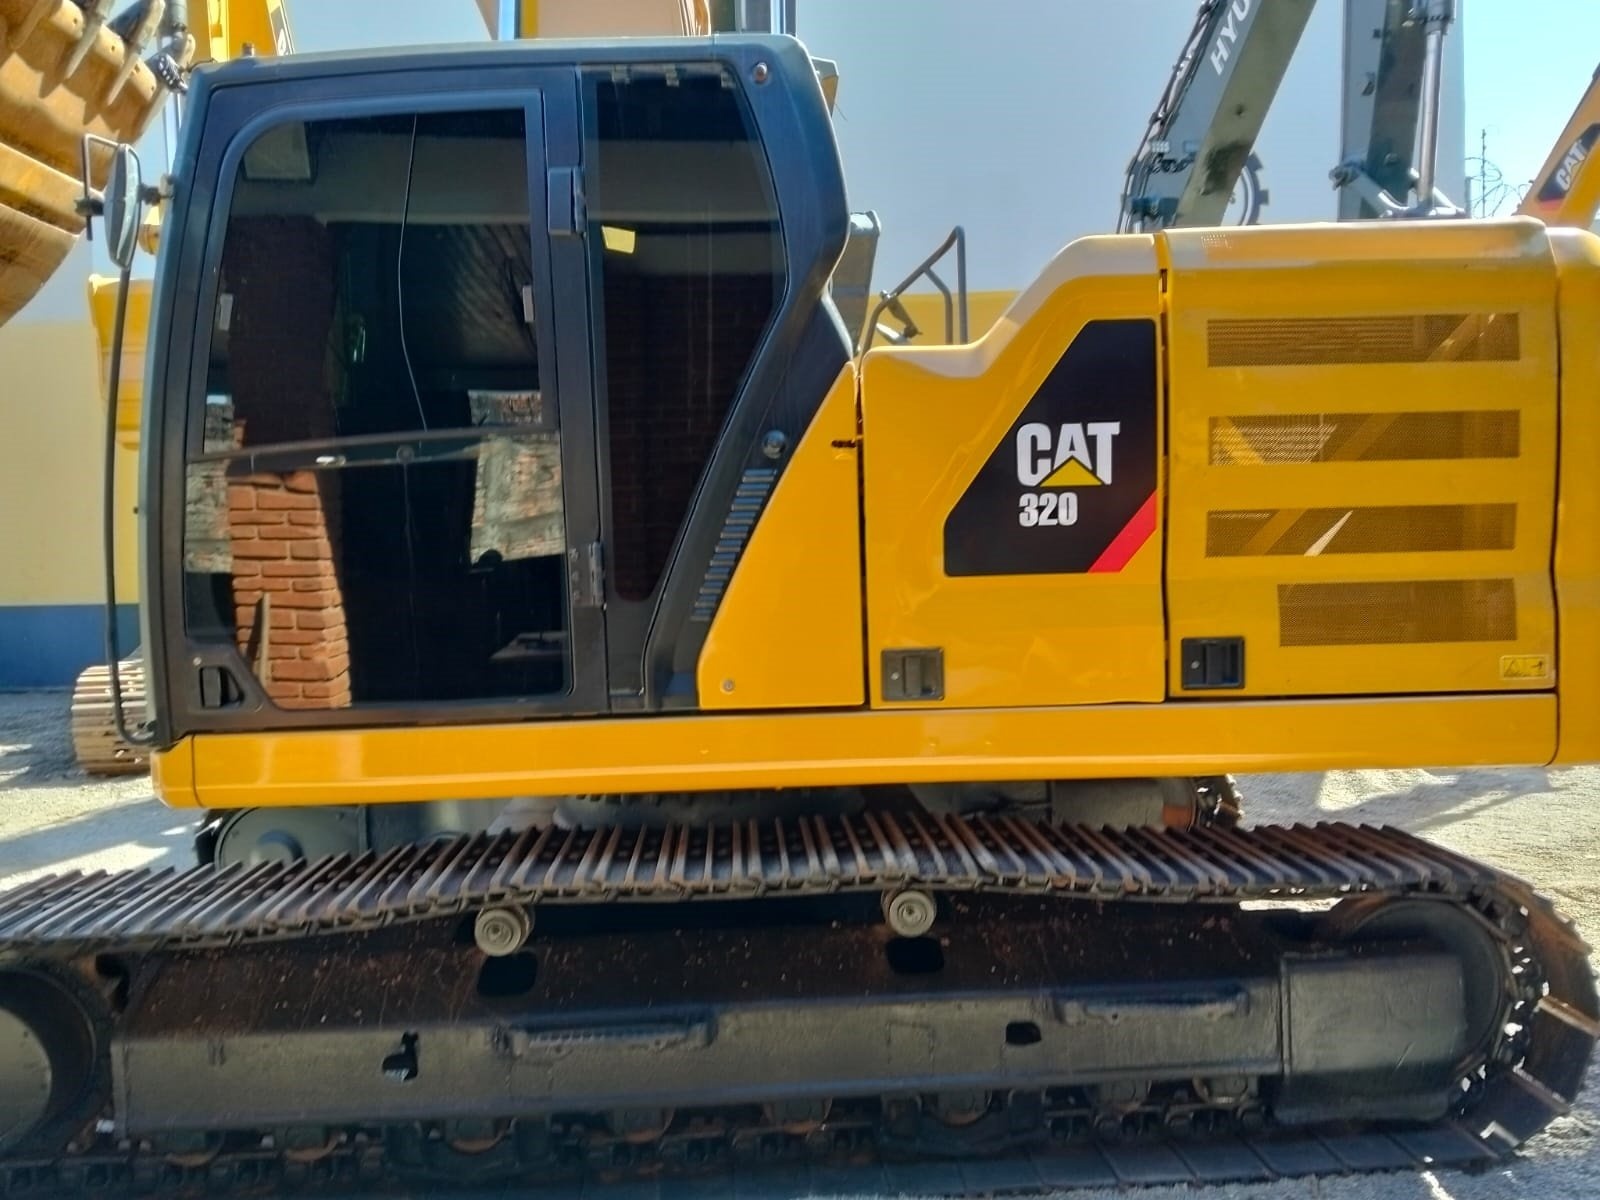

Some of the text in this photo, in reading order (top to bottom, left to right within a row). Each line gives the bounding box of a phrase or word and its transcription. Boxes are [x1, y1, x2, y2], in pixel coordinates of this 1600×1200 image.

[1556, 140, 1587, 191] CAT
[1016, 421, 1121, 487] CAT
[1018, 492, 1078, 527] 320
